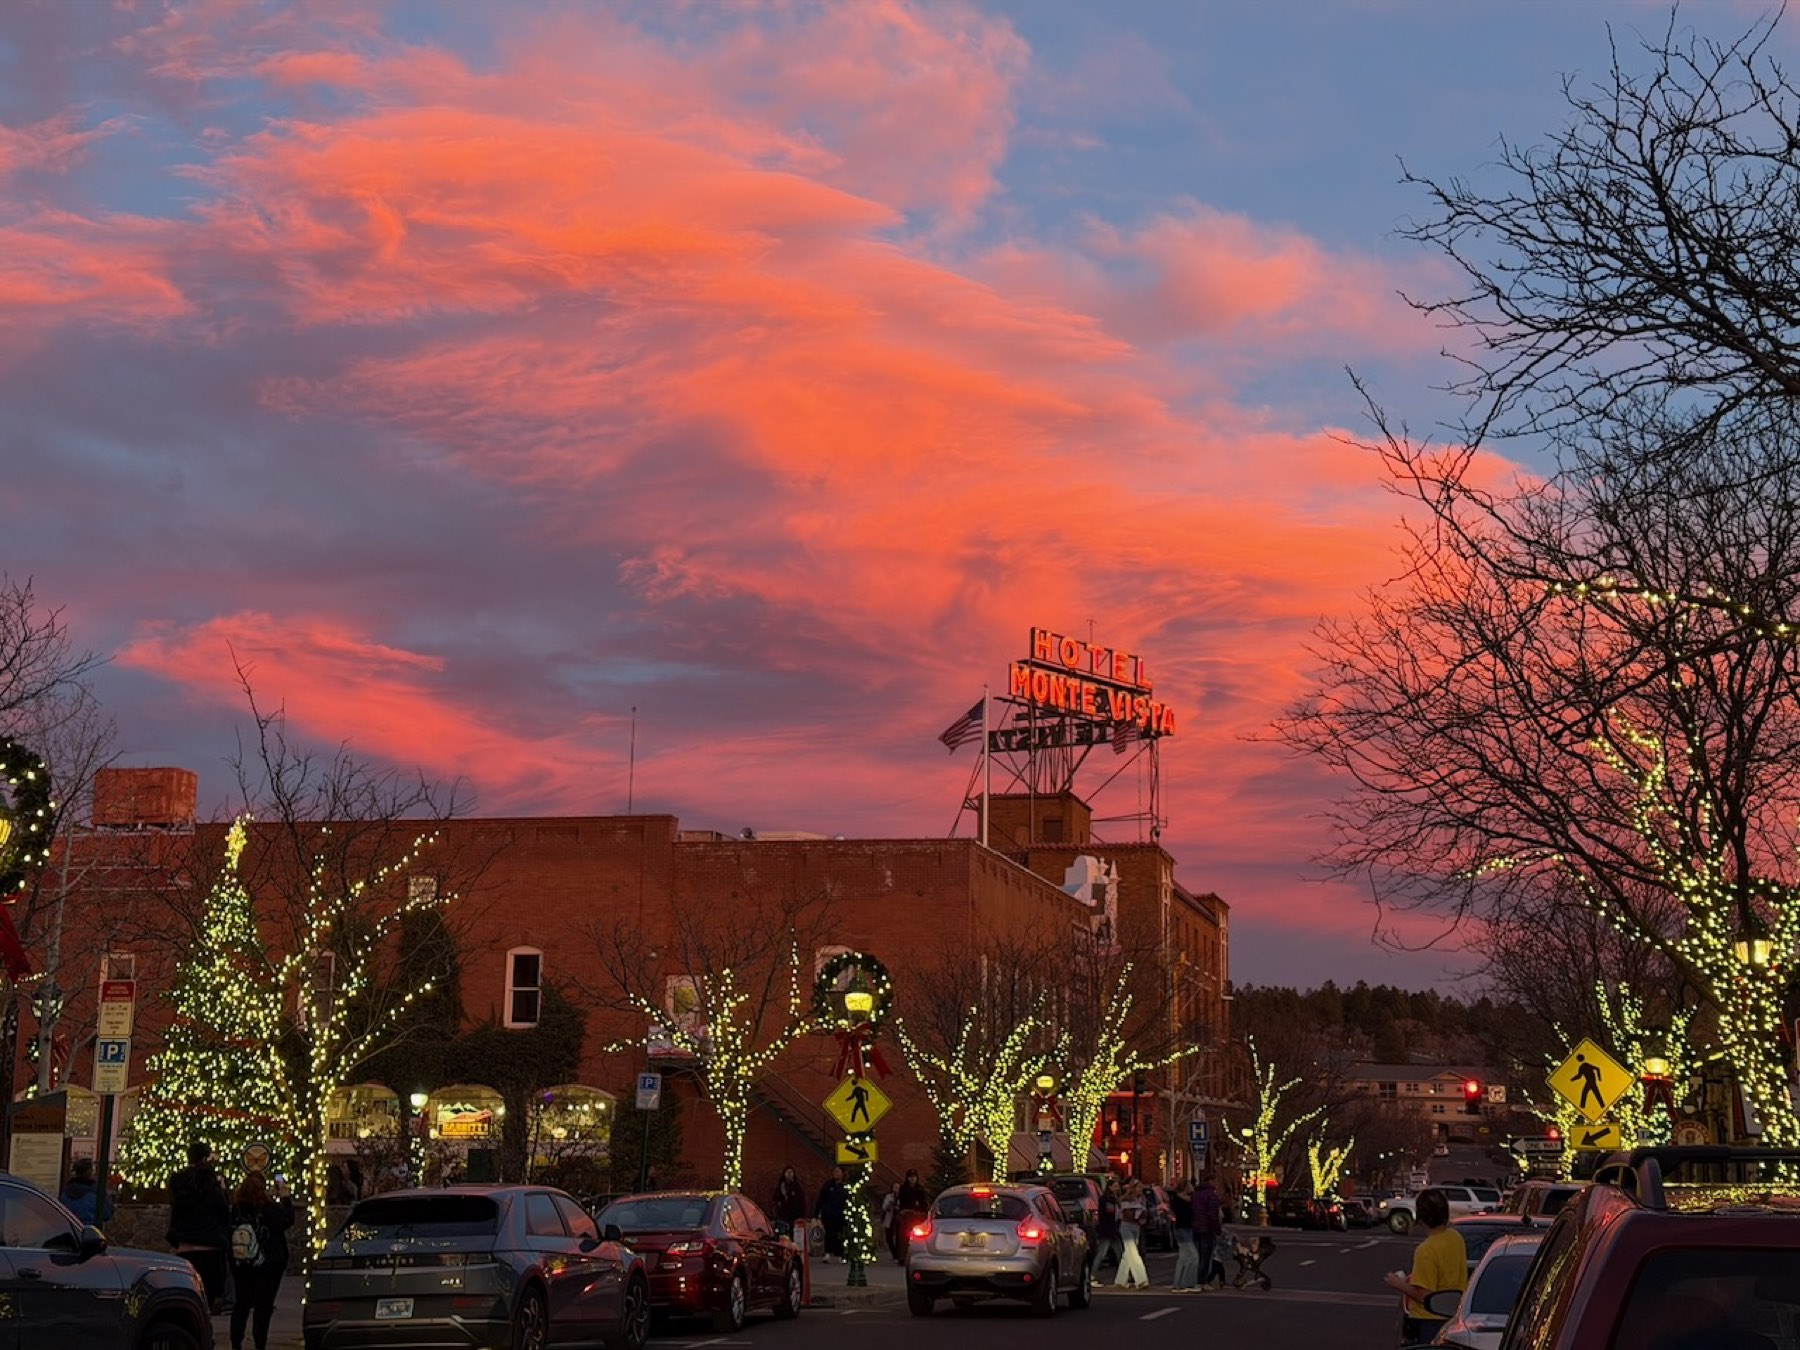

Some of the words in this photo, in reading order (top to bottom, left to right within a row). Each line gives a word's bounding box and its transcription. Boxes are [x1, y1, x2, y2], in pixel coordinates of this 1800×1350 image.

[1034, 629, 1152, 689] HOTEL
[1010, 662, 1097, 715] MONTE
[1108, 687, 1175, 735] VISTA
[107, 1044, 119, 1060] P
[645, 1078, 654, 1088] P
[1192, 1123, 1205, 1140] H
[1525, 1142, 1540, 1150] ONE
[1543, 1141, 1559, 1150] WAY
